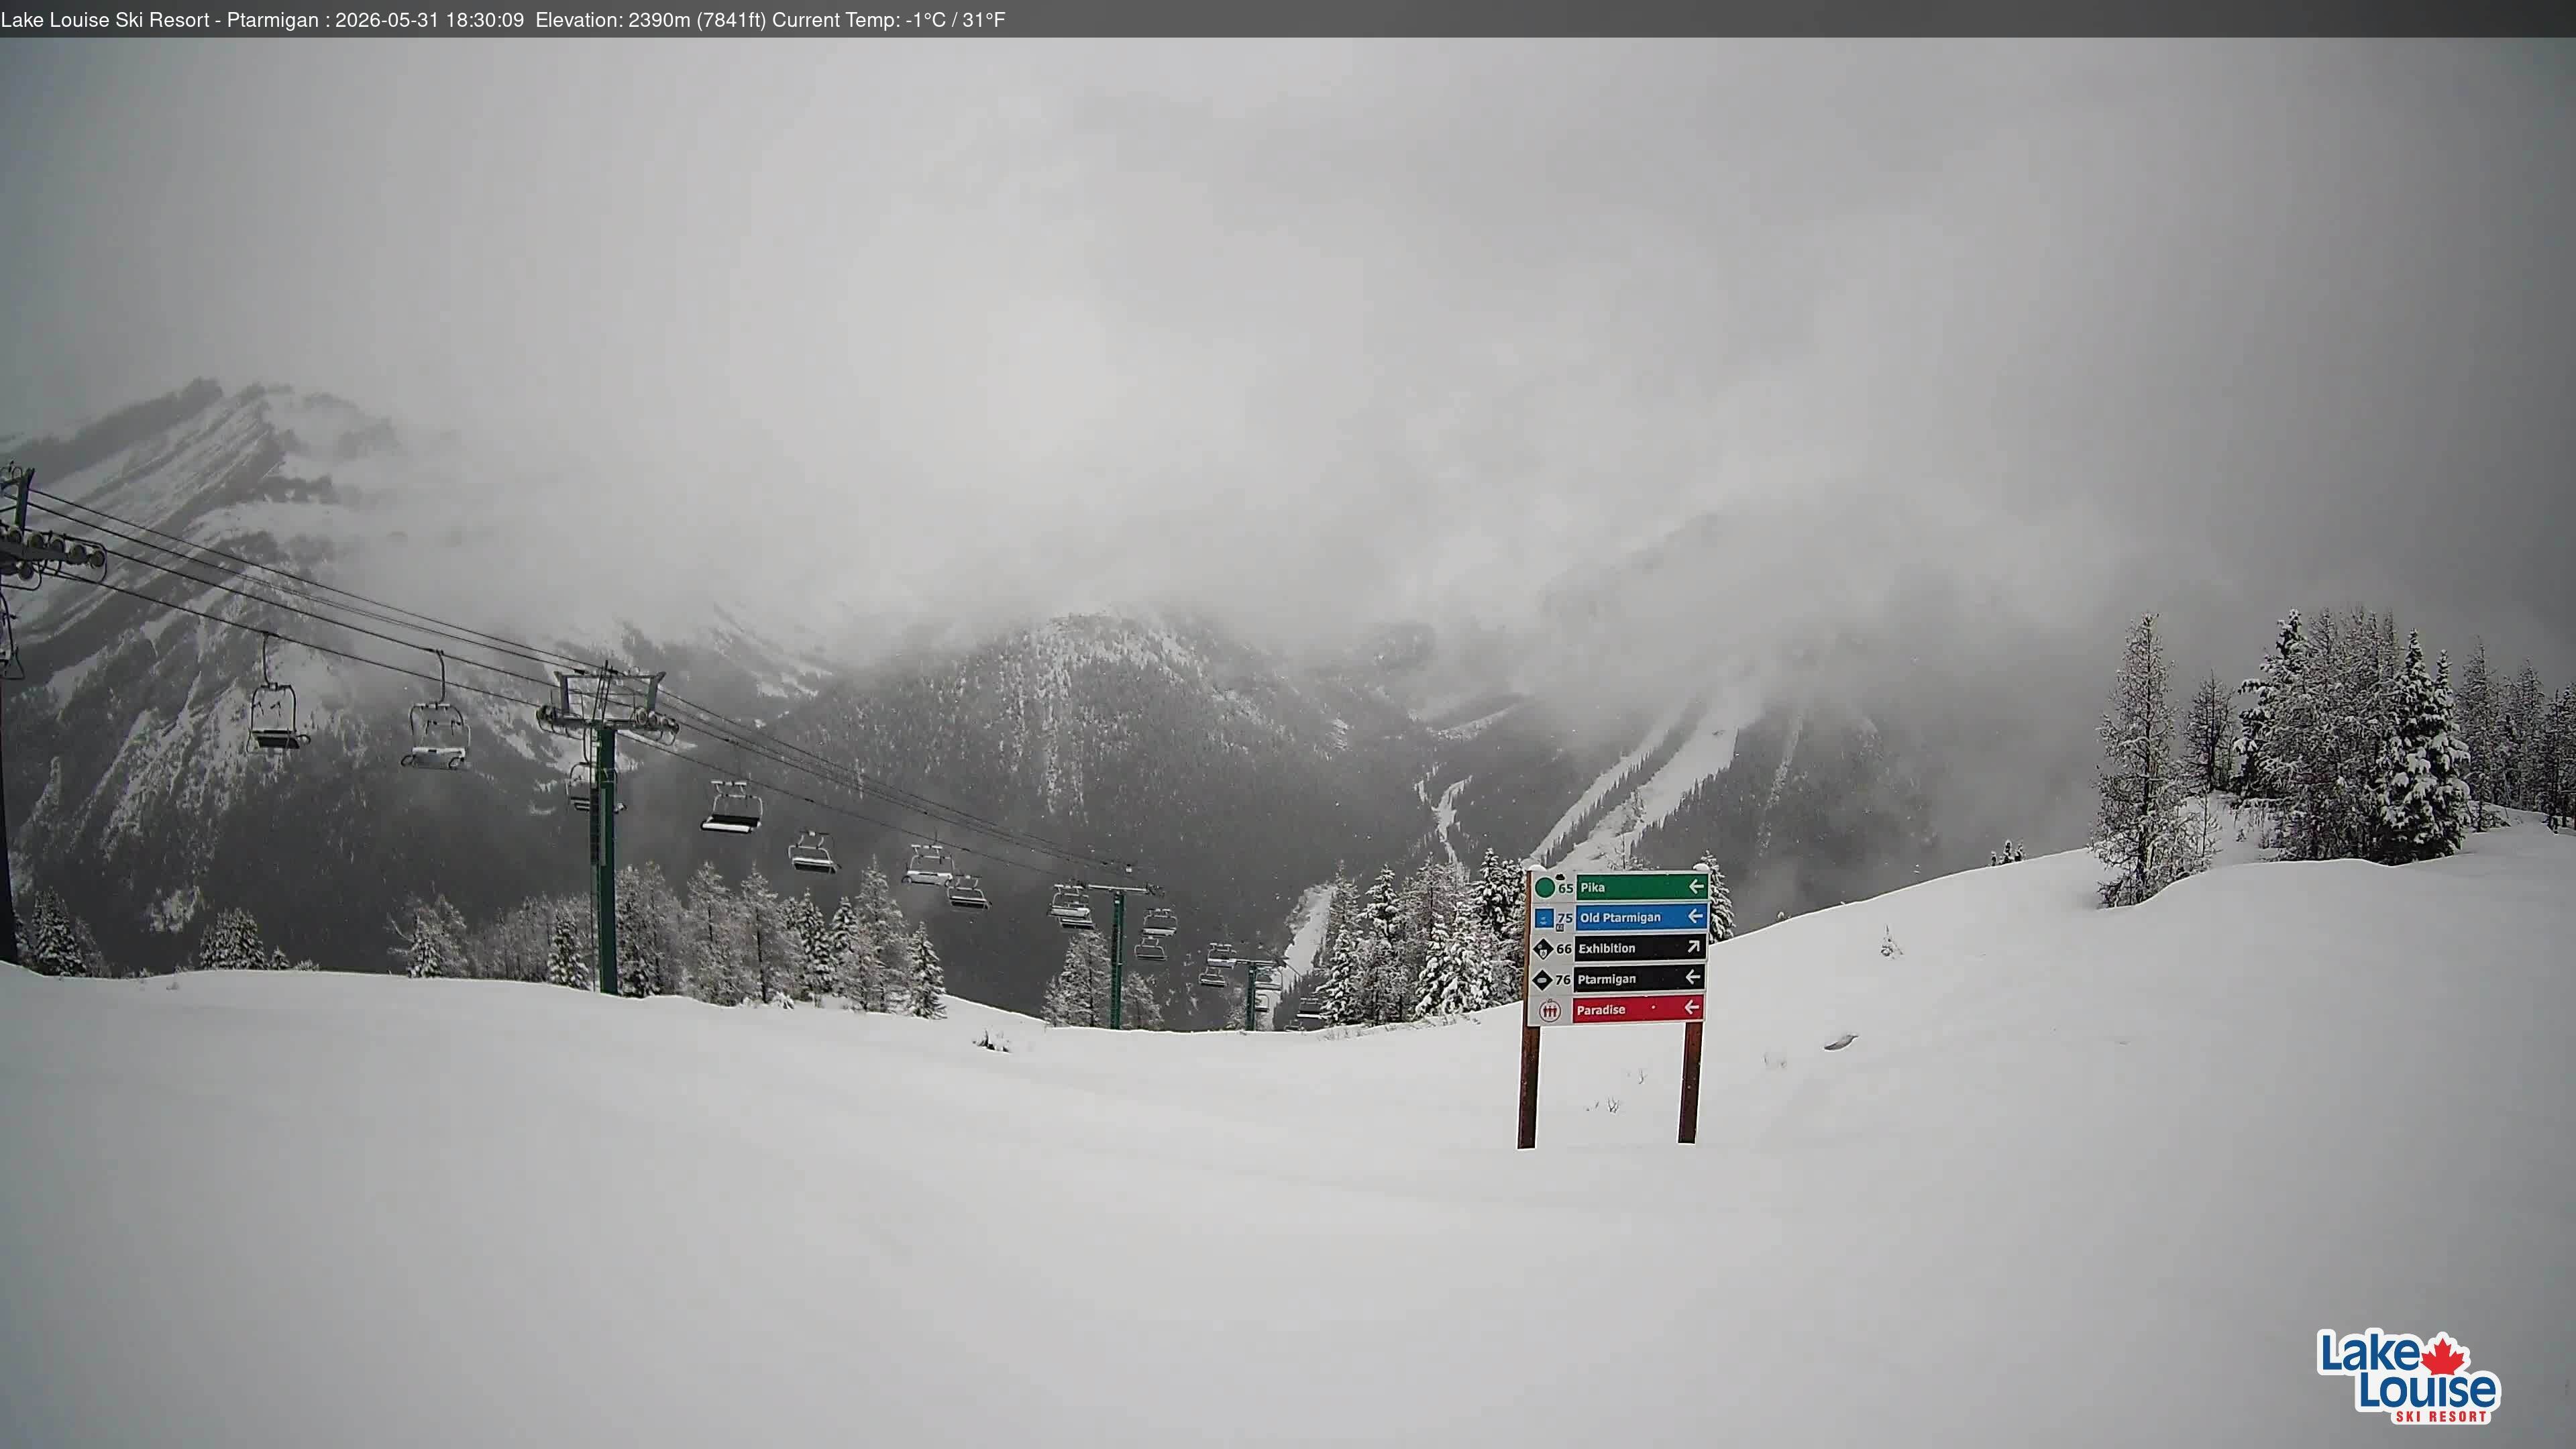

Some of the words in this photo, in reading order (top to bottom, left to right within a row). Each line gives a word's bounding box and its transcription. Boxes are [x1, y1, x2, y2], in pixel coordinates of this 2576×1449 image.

[1558, 883, 1574, 894] 65
[1580, 882, 1605, 893] Pika
[1558, 913, 1573, 924] 75
[1580, 913, 1600, 923] Old
[1603, 909, 1661, 924] Ptarmigan
[1556, 944, 1572, 954] 66
[1578, 943, 1635, 954] Exhibition
[1556, 975, 1571, 985] 76
[1578, 973, 1636, 986] Ptarmigan
[1577, 1004, 1626, 1016] Paradise
